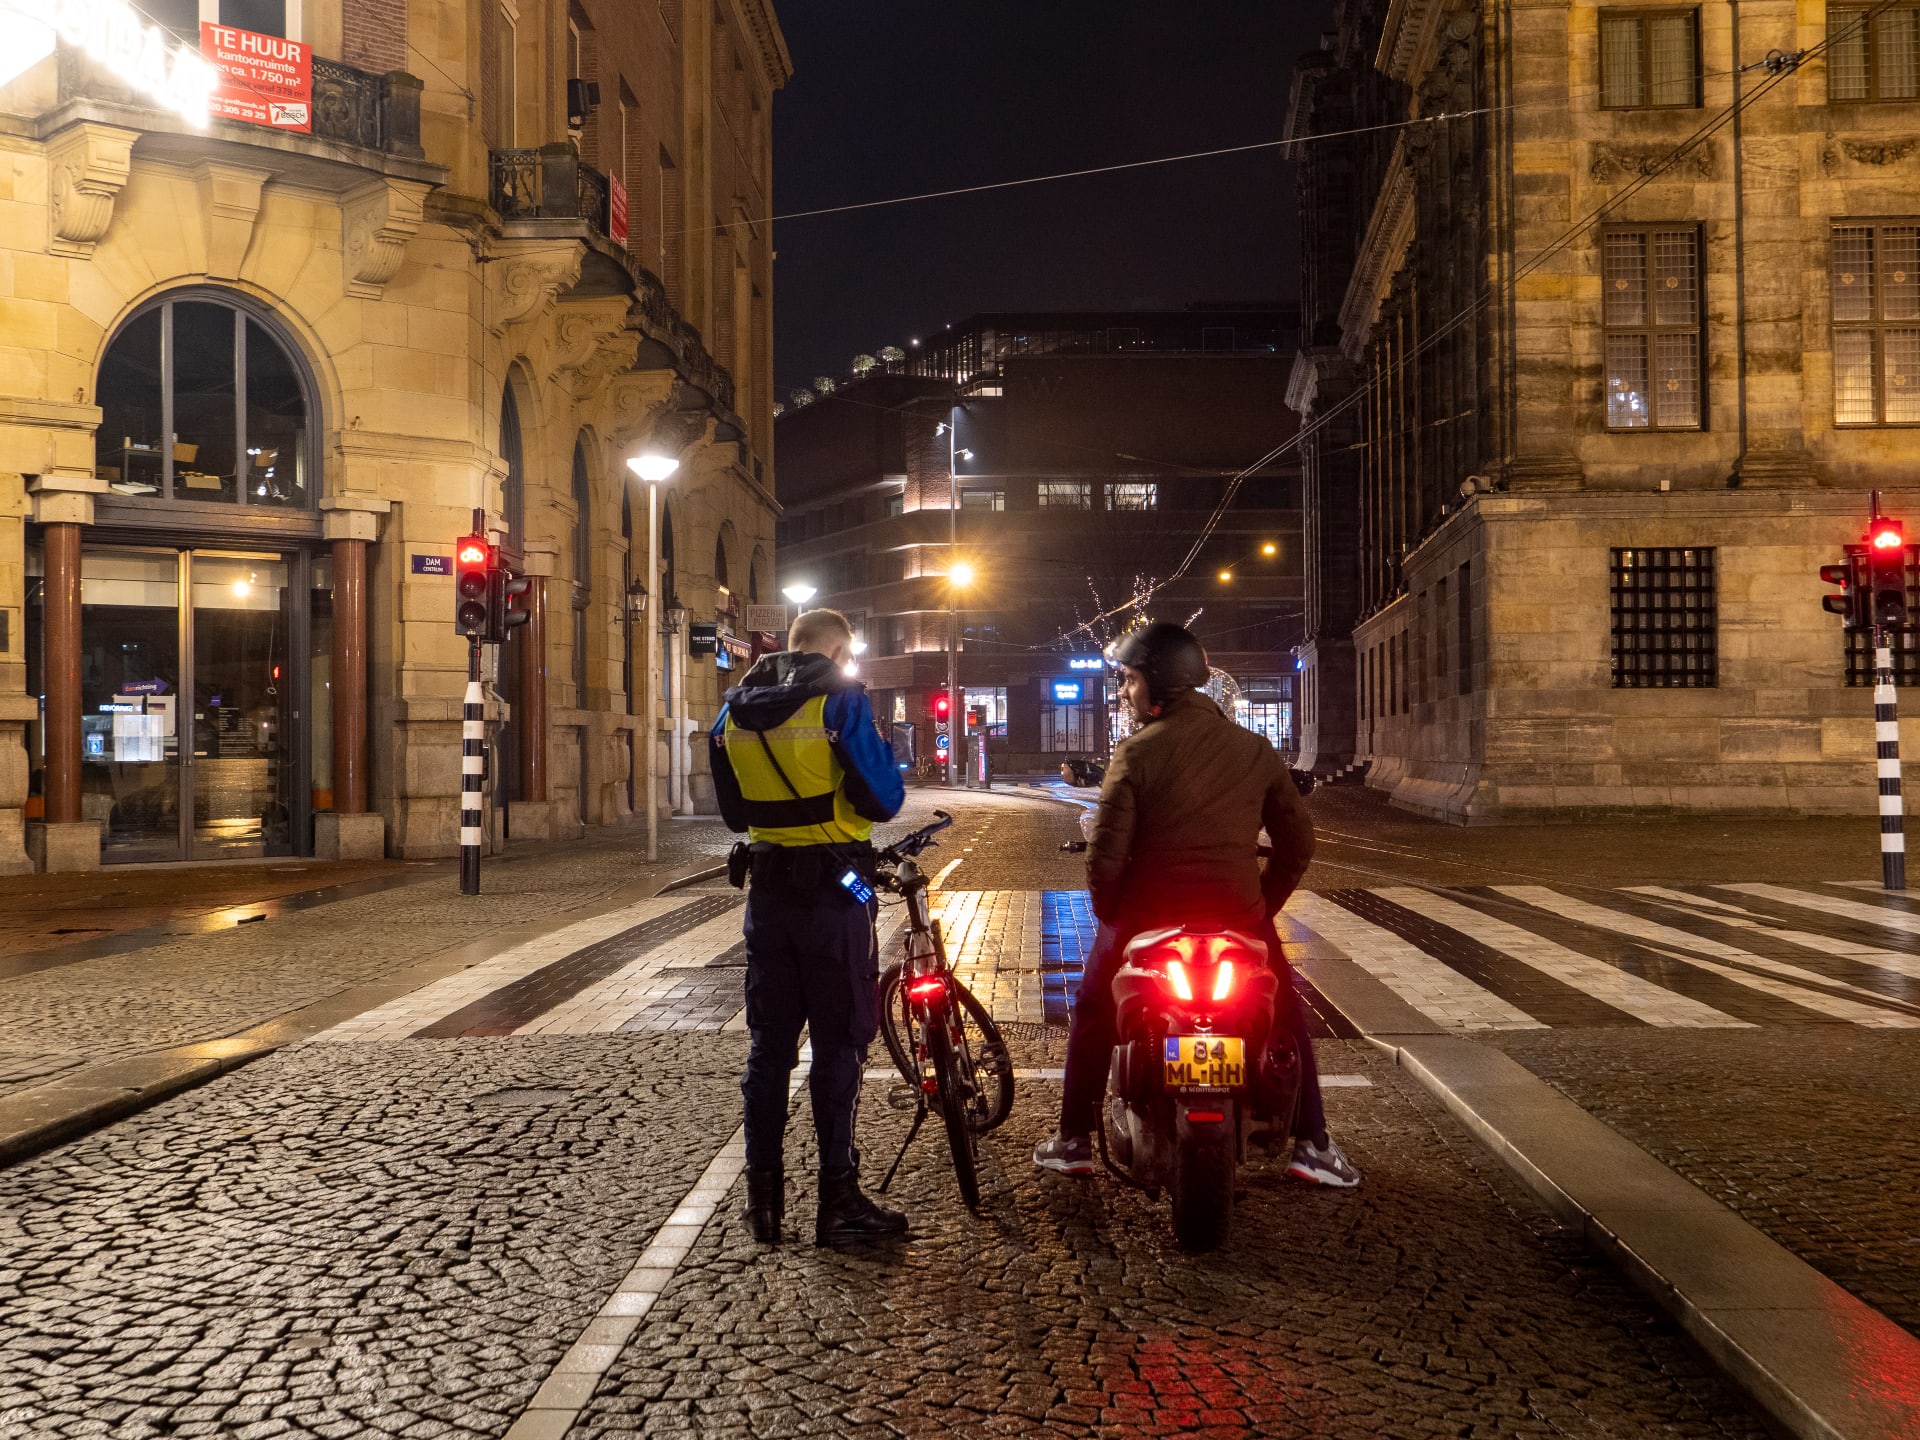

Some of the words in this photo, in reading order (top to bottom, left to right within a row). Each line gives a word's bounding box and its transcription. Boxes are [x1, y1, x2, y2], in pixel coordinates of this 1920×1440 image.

[209, 26, 236, 49] TE
[241, 33, 301, 62] HUUR
[217, 48, 296, 74] kantoorruimte
[231, 65, 247, 77] ca.
[250, 68, 284, 85] 1.750
[223, 105, 240, 115] 305
[241, 108, 254, 118] 29
[254, 110, 266, 120] 29
[425, 558, 441, 566] DAM
[750, 608, 784, 618] PIZZERIA
[754, 618, 780, 627] PIAZZA
[1194, 1040, 1226, 1060] 84
[1167, 1062, 1240, 1084] ML-HH
